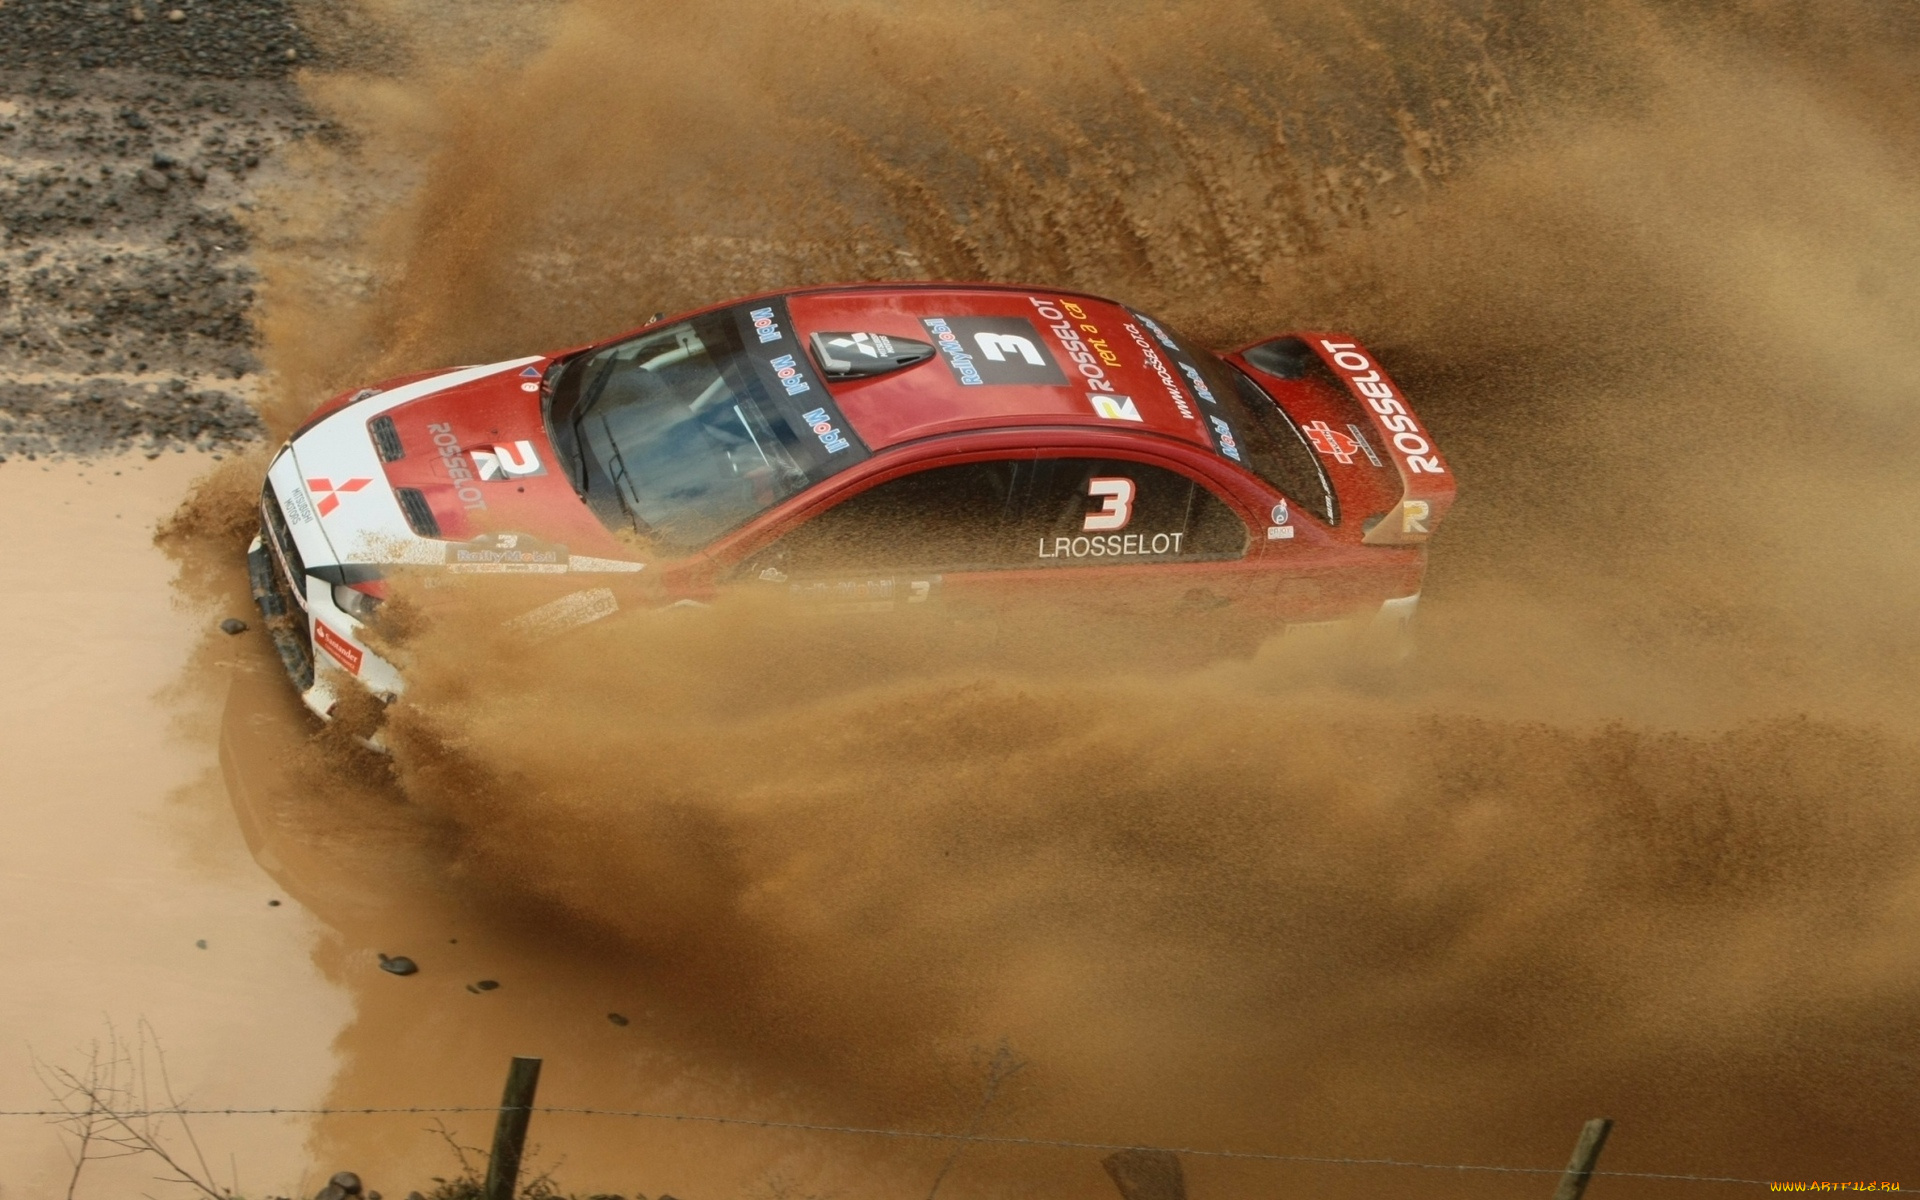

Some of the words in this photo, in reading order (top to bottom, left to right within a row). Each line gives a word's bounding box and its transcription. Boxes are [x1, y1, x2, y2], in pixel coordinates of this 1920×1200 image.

[750, 307, 782, 344] Mobil
[1059, 299, 1087, 320] car
[1028, 296, 1115, 392] ROSSELOT
[1080, 323, 1098, 334] a
[973, 332, 1046, 367] 3
[1087, 338, 1122, 368] rent
[770, 354, 810, 396] Mobil
[1178, 361, 1217, 405] Mobil
[1091, 395, 1144, 423] R
[1321, 338, 1445, 475] ROSSELOT
[802, 407, 850, 454] Mobil
[1210, 415, 1241, 462] Mobil
[427, 422, 487, 511] ROSSELOT
[283, 497, 302, 526] MOTORS
[291, 487, 314, 524] MITSUBISHI
[1082, 477, 1136, 532] 3
[1403, 500, 1429, 533] R
[496, 534, 518, 549] 3
[1038, 532, 1184, 559] L.ROSSELOT
[908, 581, 930, 603] 3
